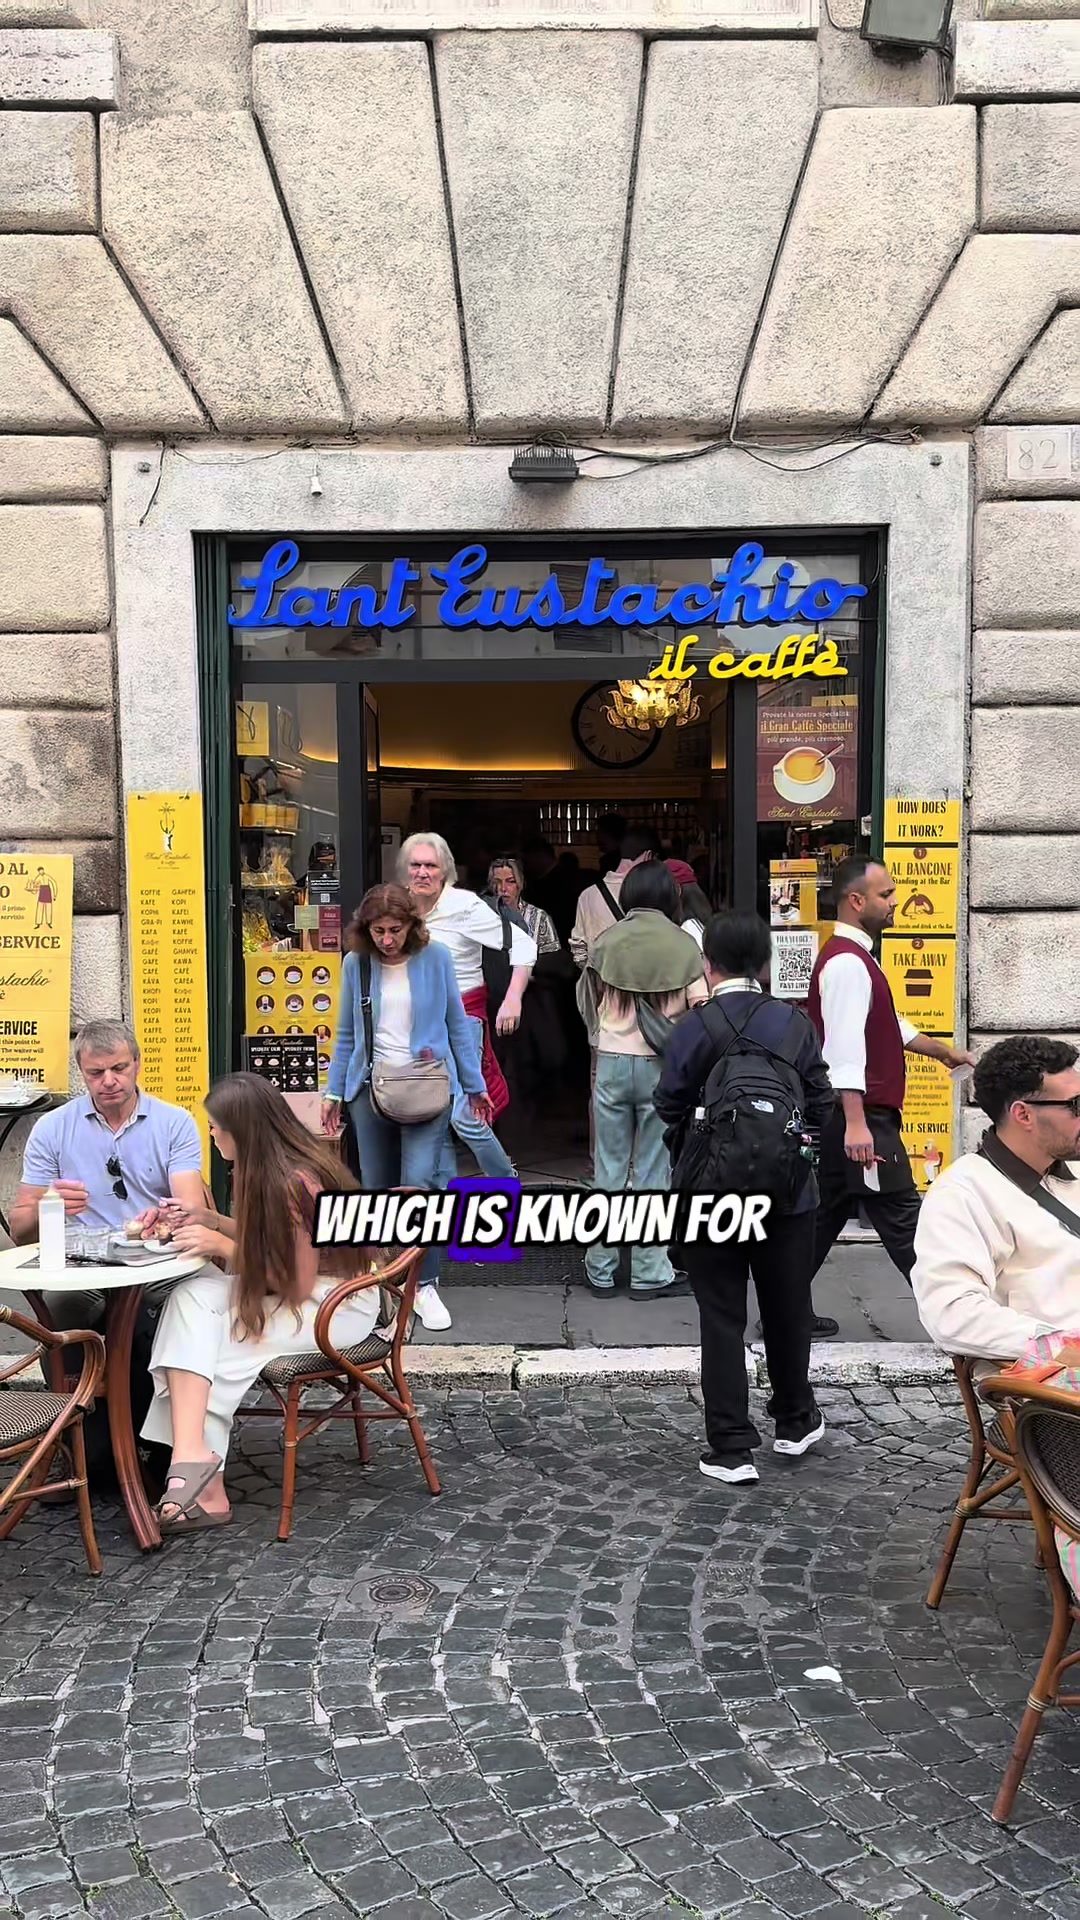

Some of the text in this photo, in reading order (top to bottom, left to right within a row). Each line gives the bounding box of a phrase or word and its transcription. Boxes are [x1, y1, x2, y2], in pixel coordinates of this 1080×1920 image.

[1019, 439, 1058, 470] 82
[430, 542, 867, 627] Eustachio
[649, 634, 849, 680] il caffè
[760, 719, 853, 732] il Gran Caffè Speciale
[897, 801, 946, 814] HOW DOES
[898, 824, 944, 837] IT WORK?
[8, 862, 28, 876] AL
[891, 862, 952, 876] AL BANCONE
[0, 936, 61, 950] ERVICE
[893, 953, 948, 966] TAKE AWAY
[901, 1122, 950, 1134] ELF SERVICE
